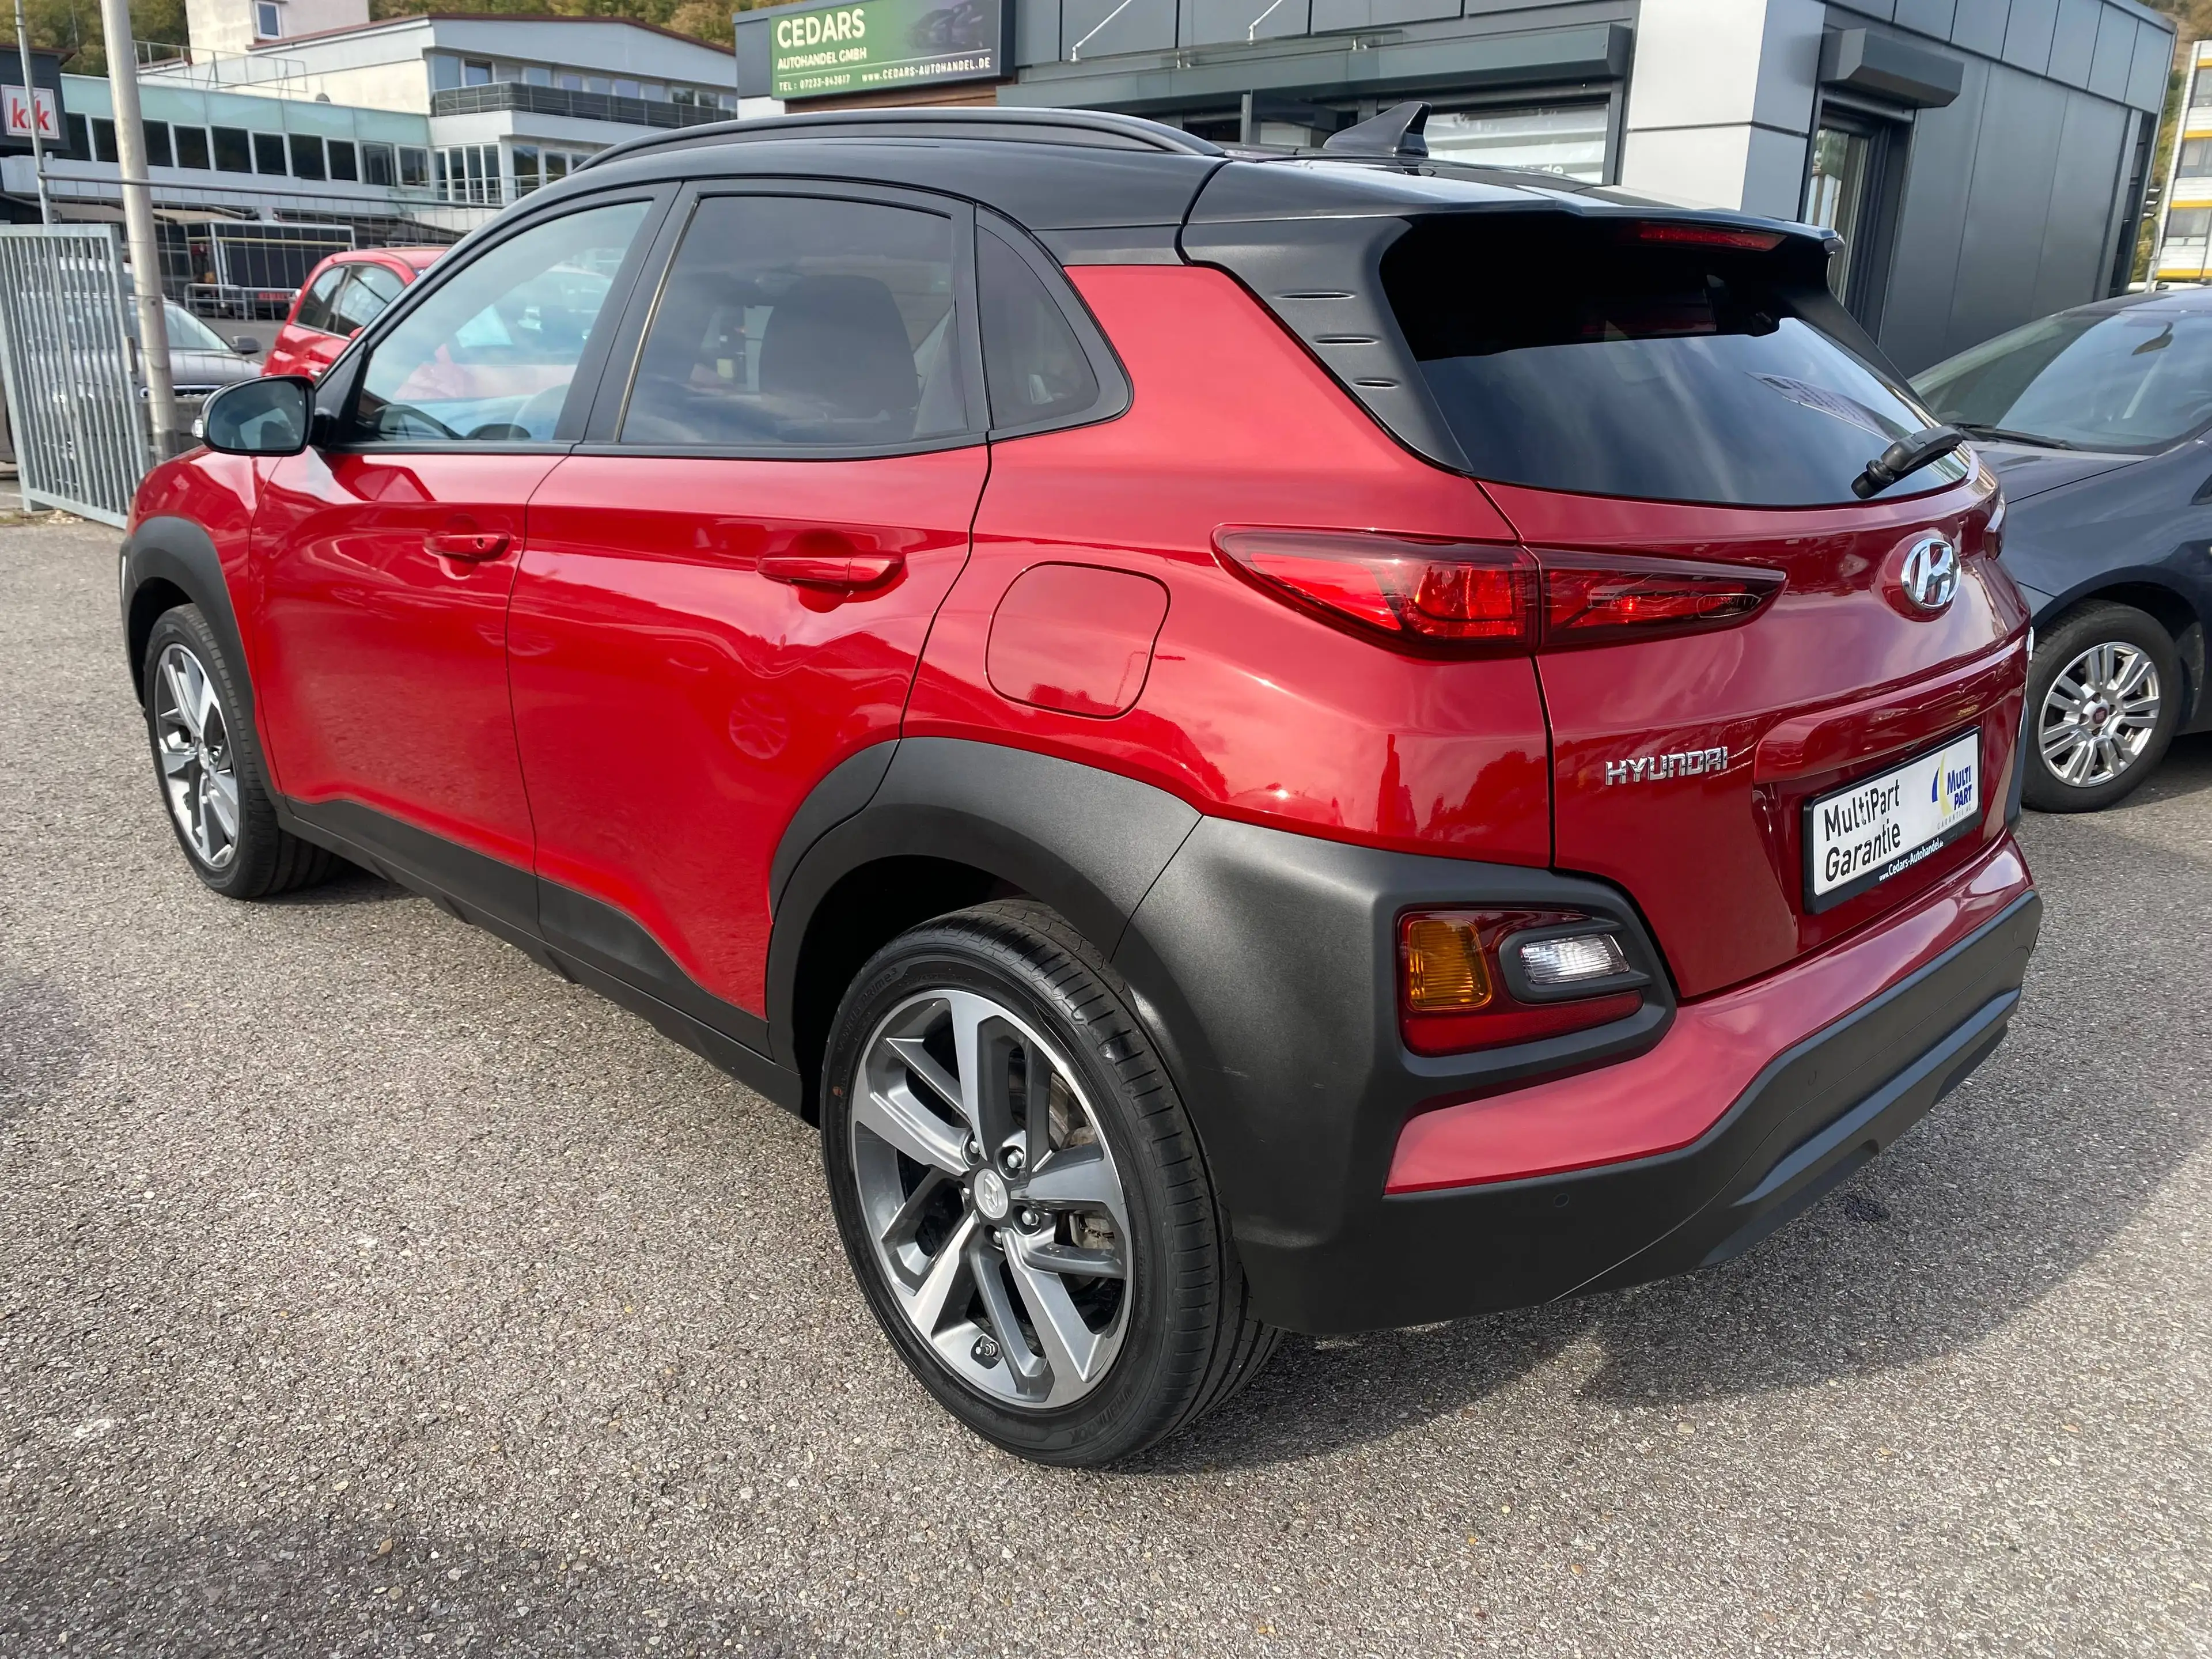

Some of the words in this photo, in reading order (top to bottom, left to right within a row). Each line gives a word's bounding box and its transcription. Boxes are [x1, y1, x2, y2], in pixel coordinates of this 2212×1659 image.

[777, 9, 865, 48] CEDARS
[777, 51, 838, 70] AUTOHANDEL
[838, 47, 867, 62] GMBH
[12, 97, 50, 131] kk
[1605, 746, 1728, 785] HYUNDAI
[1946, 764, 1971, 796] MULTI
[1824, 779, 1900, 842] MultiPart
[1954, 784, 1972, 810] PART
[1825, 819, 1901, 882] Garantie
